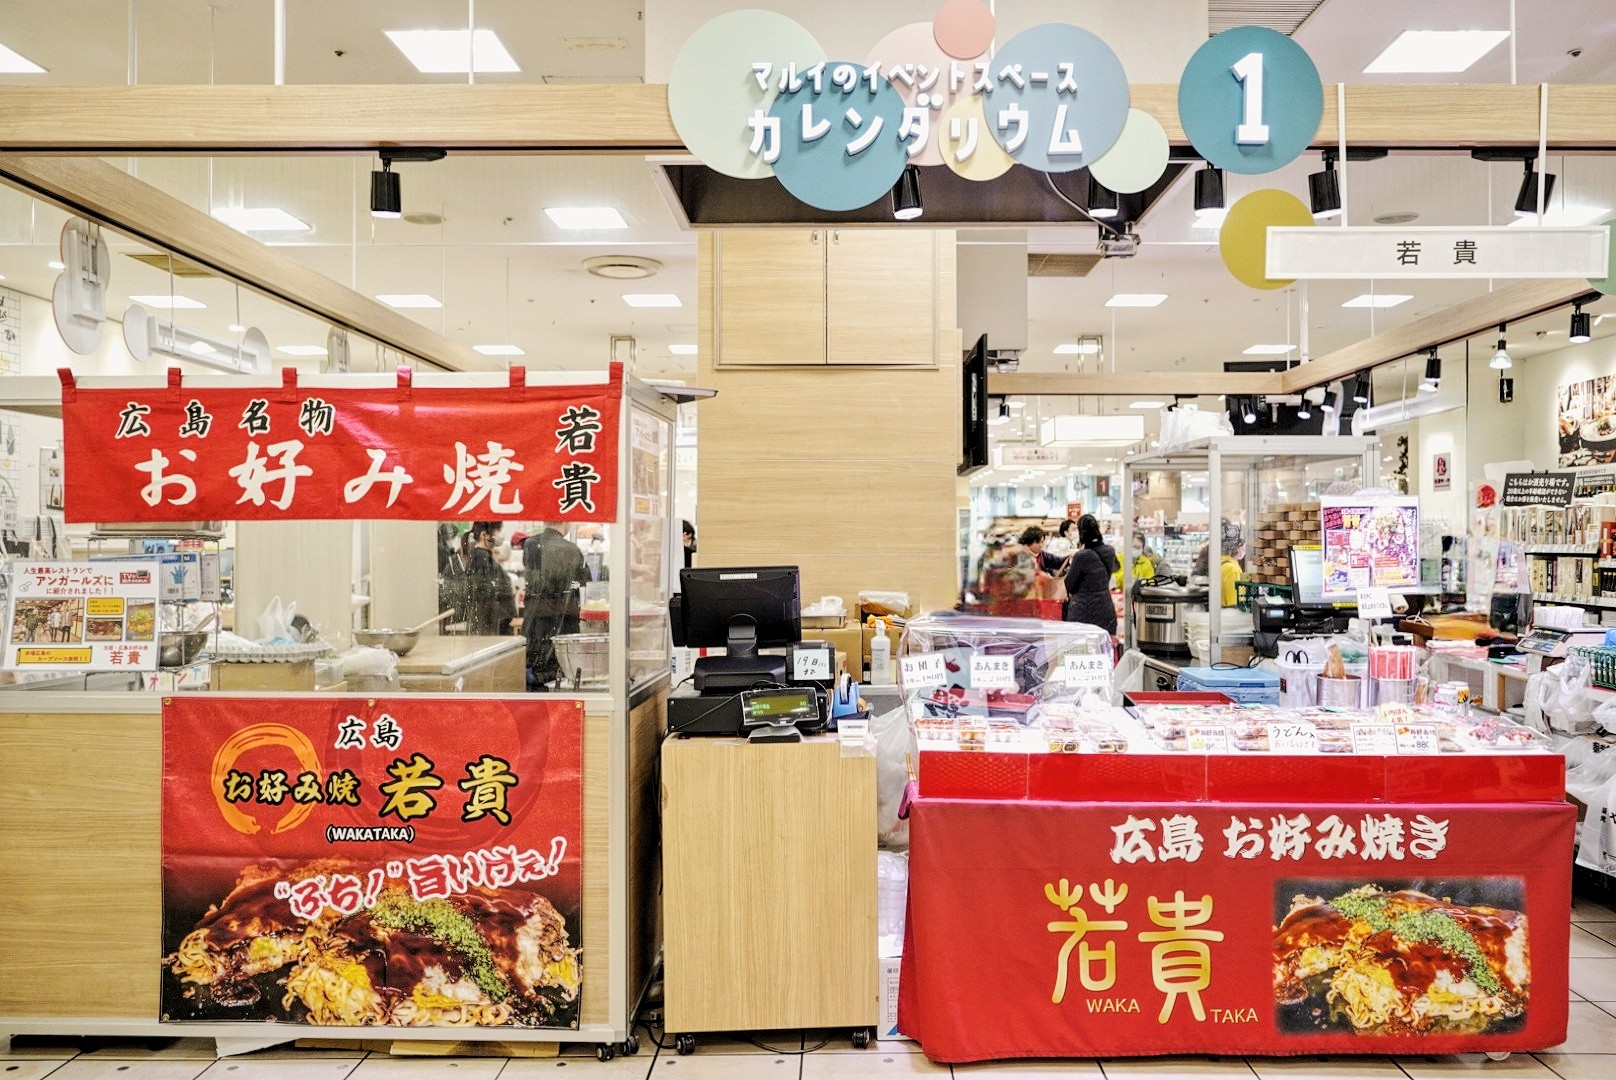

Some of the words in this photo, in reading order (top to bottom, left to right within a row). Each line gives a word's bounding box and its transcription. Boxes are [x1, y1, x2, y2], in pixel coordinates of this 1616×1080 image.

[752, 61, 1078, 95] マルイのイベントスペース
[1230, 53, 1269, 144] 1
[748, 93, 1083, 164] カレンダリウム
[1396, 240, 1478, 266] 若貴
[116, 398, 335, 439] 広島名物
[133, 440, 524, 514] お好み焼
[554, 405, 602, 514] 若貴
[36, 576, 114, 586] アンガールズに
[110, 651, 141, 665] 若貴
[974, 661, 1009, 671] あんまき
[1069, 660, 1104, 670] あんまき
[334, 714, 403, 750] 広島
[223, 769, 362, 804] お好み焼
[378, 752, 518, 826] 若貴
[326, 825, 415, 842] (WAKATAKA)
[1110, 814, 1204, 864] 広島
[1222, 813, 1450, 861] お好み焼き
[1044, 878, 1225, 1025] 若貴
[1086, 999, 1141, 1013] WAKA
[1210, 1008, 1259, 1023] TAKA
